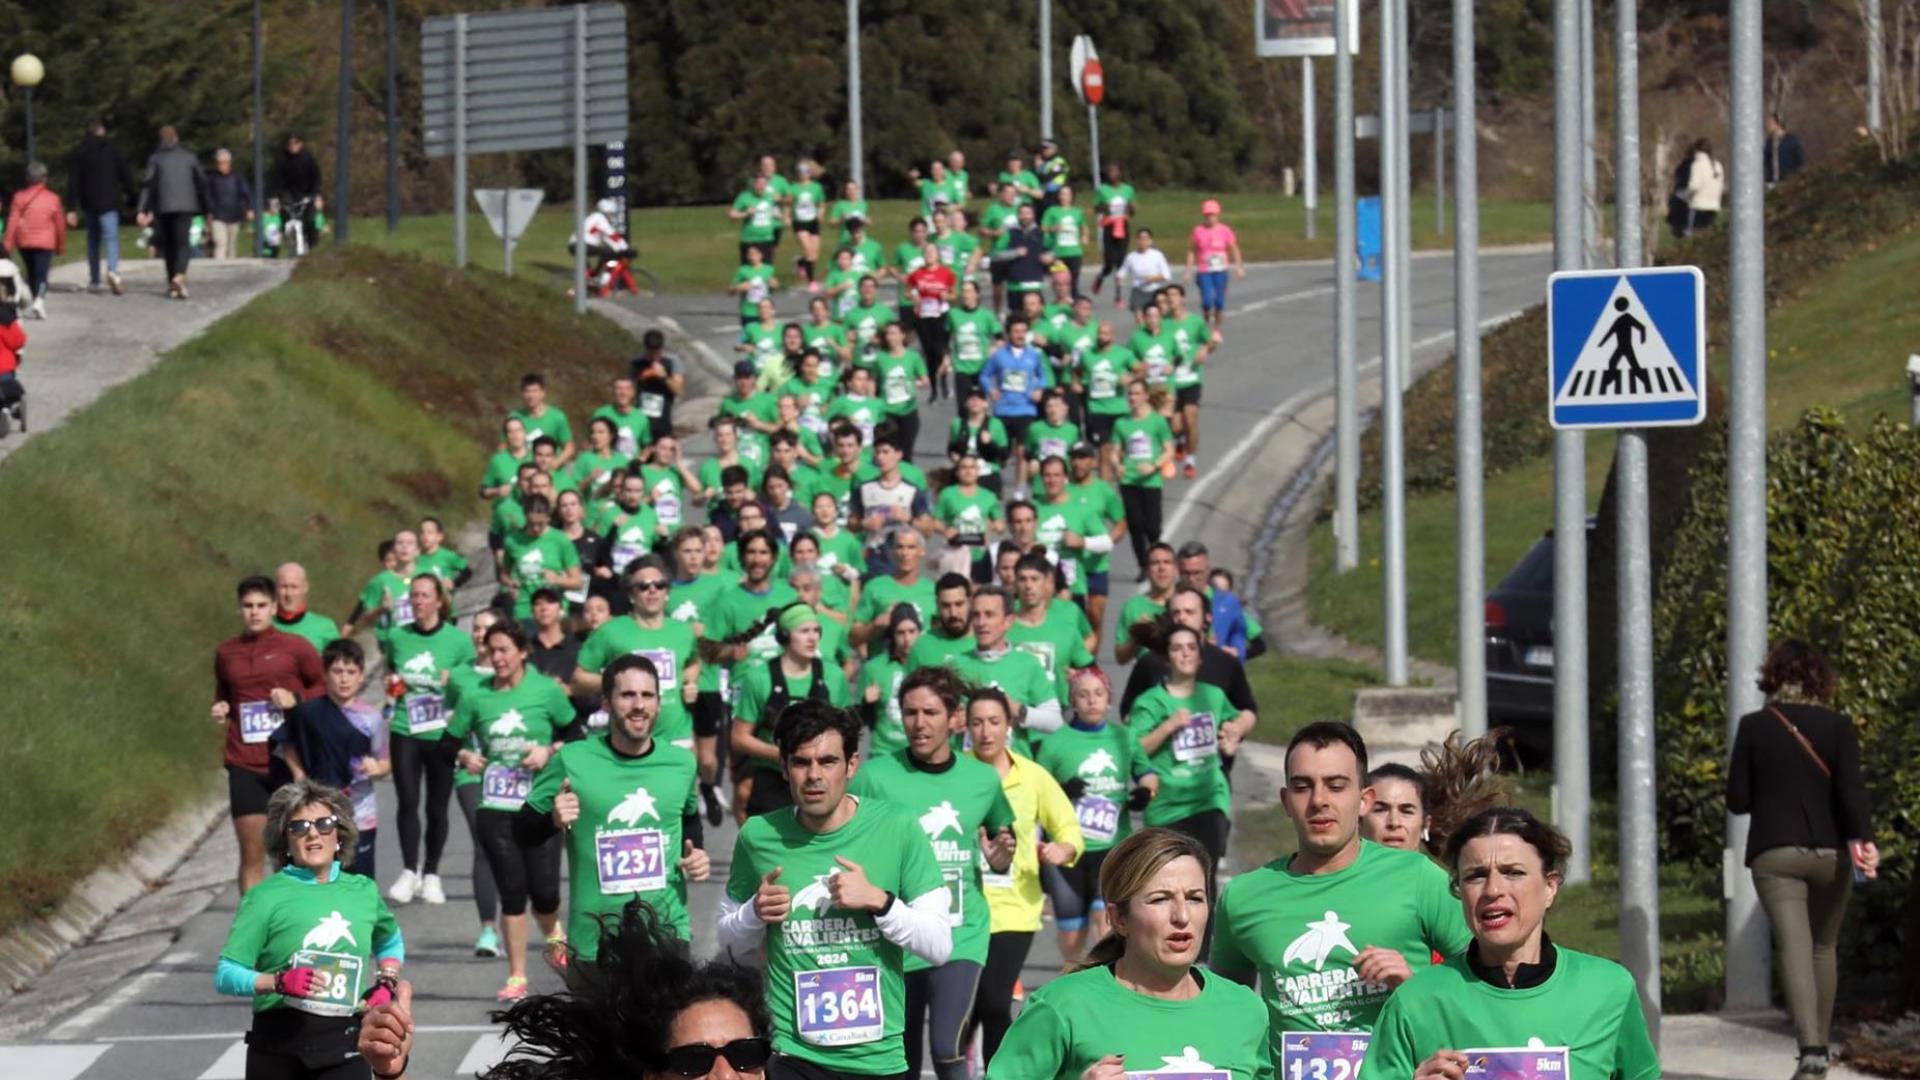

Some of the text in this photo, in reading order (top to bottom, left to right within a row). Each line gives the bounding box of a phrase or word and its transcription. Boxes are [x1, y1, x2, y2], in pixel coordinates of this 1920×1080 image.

[603, 847, 659, 876] 1237
[781, 917, 857, 933] CARRERA
[790, 928, 880, 947] VALIENTES
[816, 952, 849, 966] 2024
[855, 972, 875, 983] 5km
[1276, 966, 1360, 993] CARRERA
[1292, 980, 1389, 1006] VALIENTES
[804, 987, 877, 1024] 1364
[1314, 1009, 1352, 1026] 2024
[1289, 1057, 1364, 1080] 132
[1536, 1058, 1562, 1072] 5km
